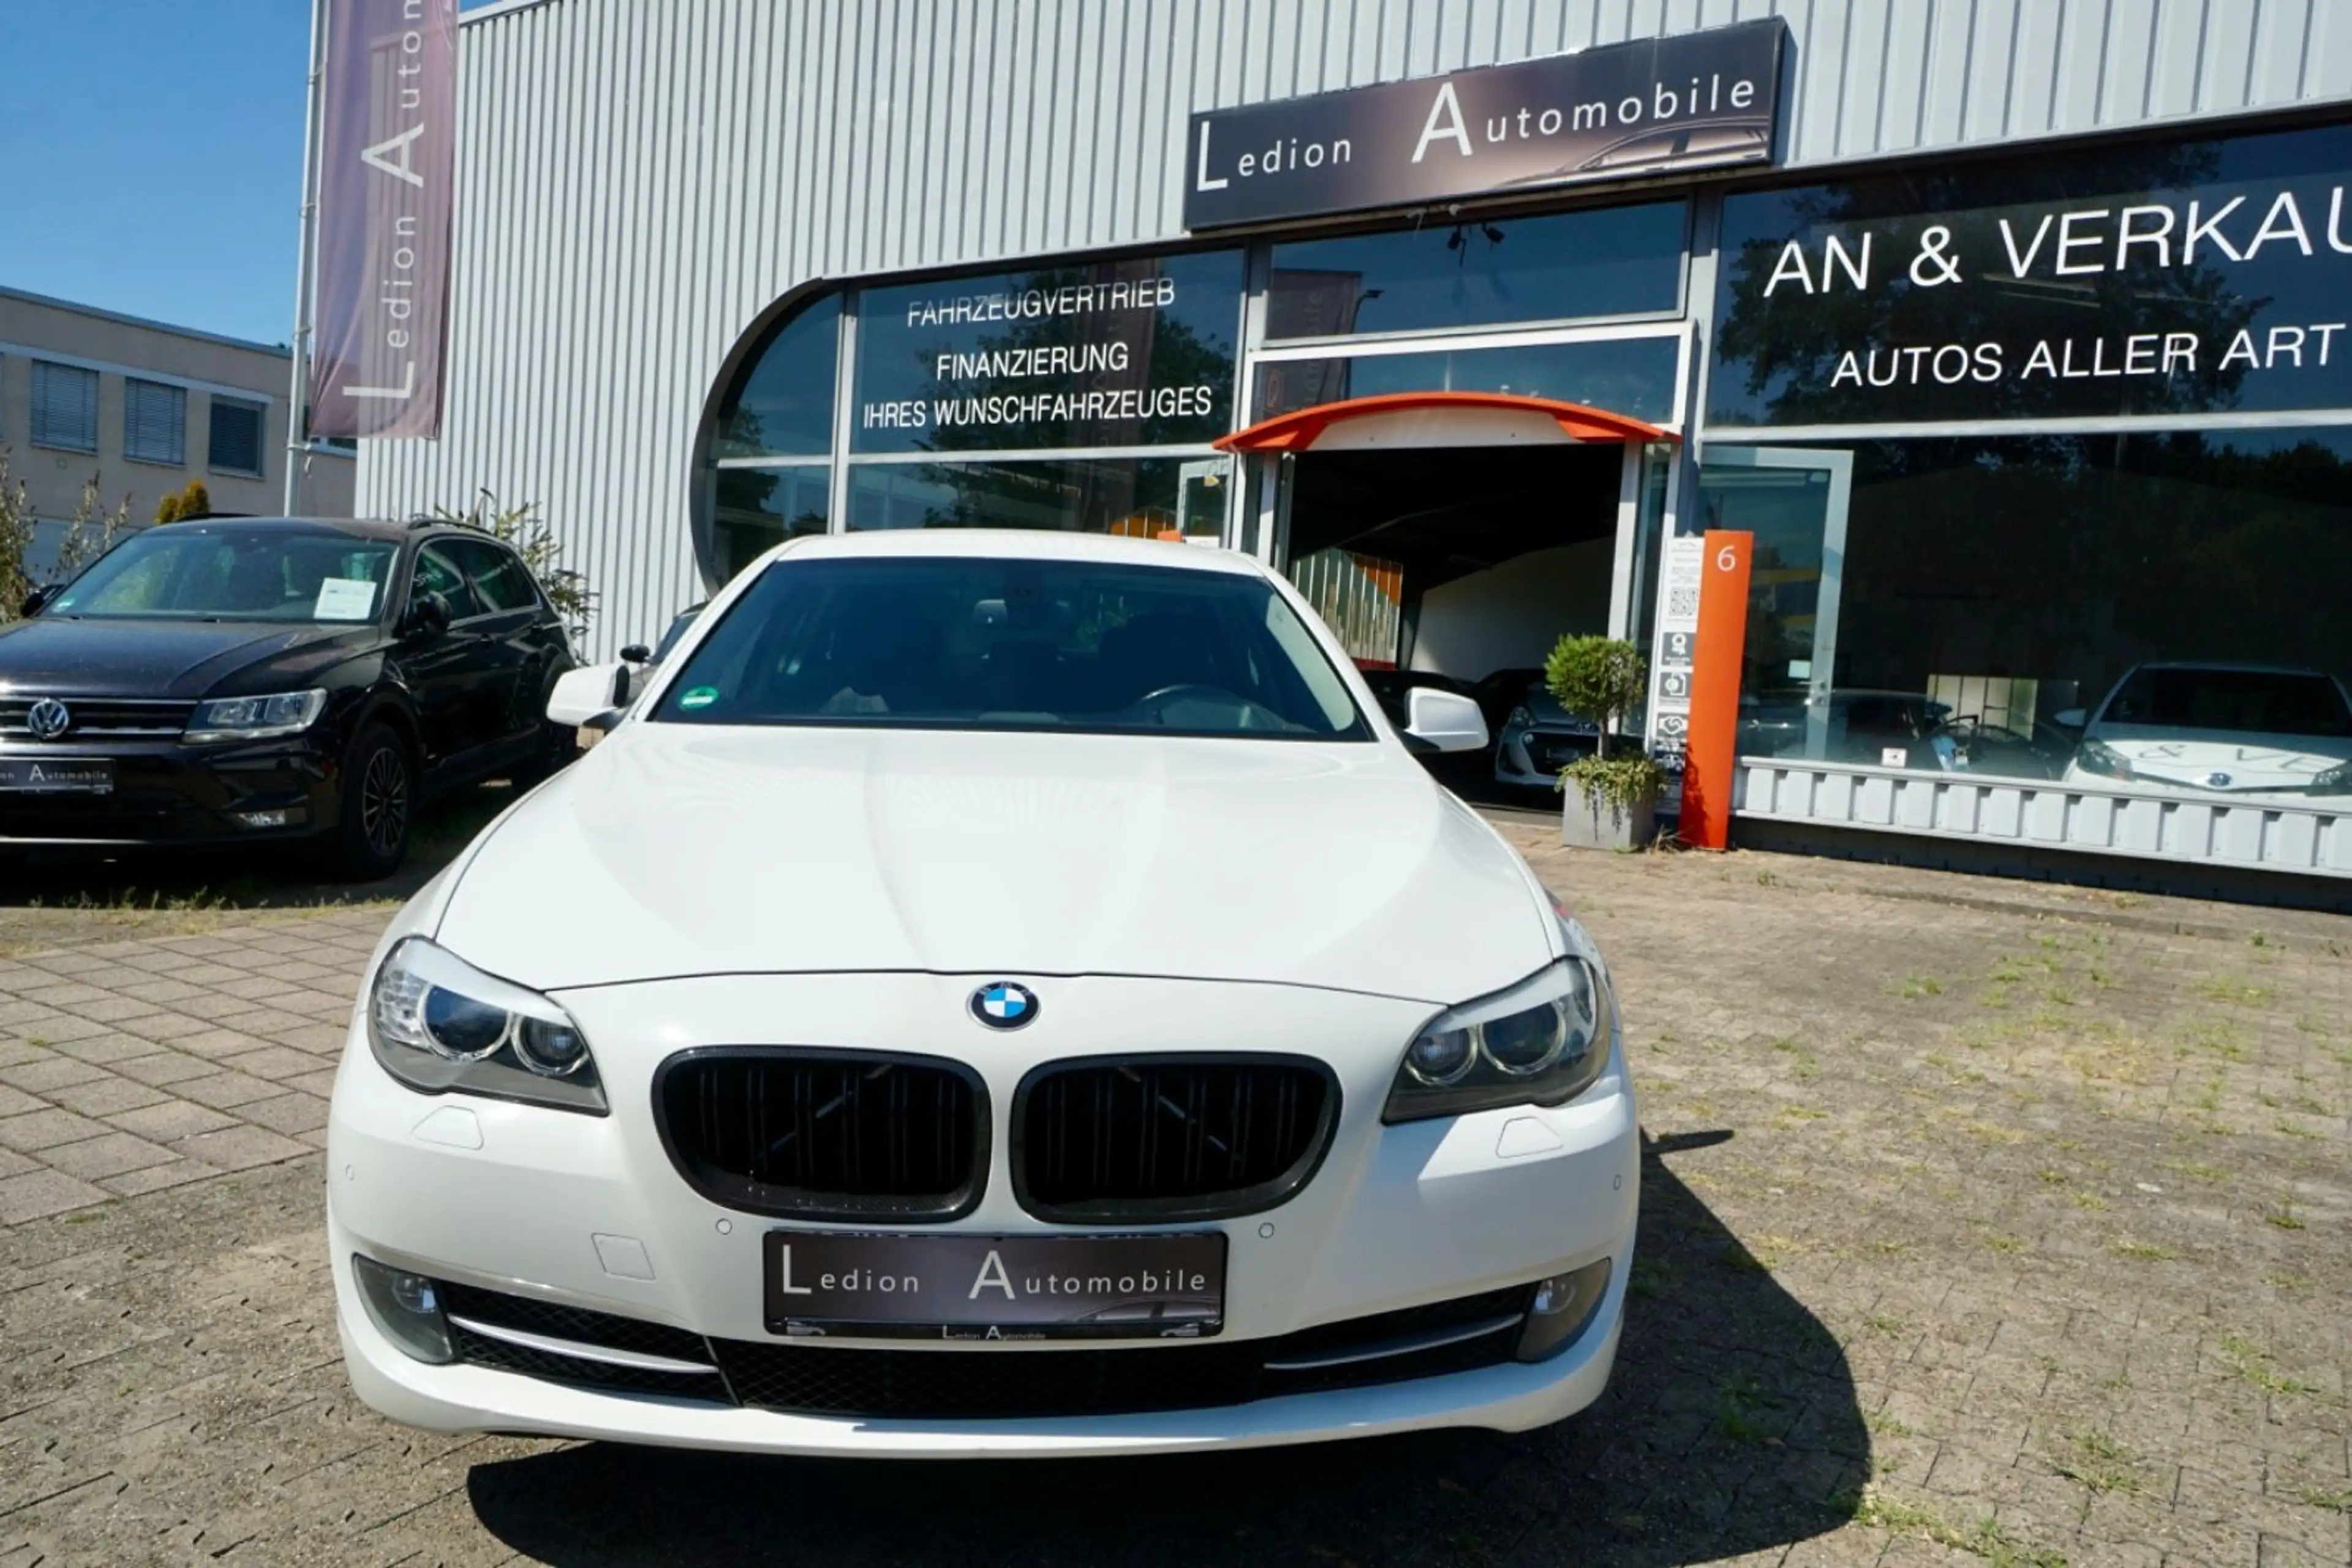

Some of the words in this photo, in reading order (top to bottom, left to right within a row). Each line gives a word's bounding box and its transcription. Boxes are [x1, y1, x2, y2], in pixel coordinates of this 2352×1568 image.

[1196, 120, 1352, 192] Ledion
[1410, 74, 1755, 164] Automobile
[1763, 232, 1872, 298] AN
[1909, 224, 1964, 288] &
[341, 216, 417, 399] Ledion
[907, 277, 1175, 327] FAHRZEUGVERTRIEB
[937, 341, 1129, 381] FINANZIERUNG
[1830, 343, 2003, 388] AUTOS
[2021, 333, 2199, 380] ALLER
[2218, 322, 2347, 371] ART
[864, 400, 926, 429] IHRES
[934, 385, 1212, 426] WUNSCHFAHRZEUGES
[1716, 545, 1736, 572] 6
[783, 1243, 919, 1294] Ledion
[967, 1249, 1207, 1300] Automobile
